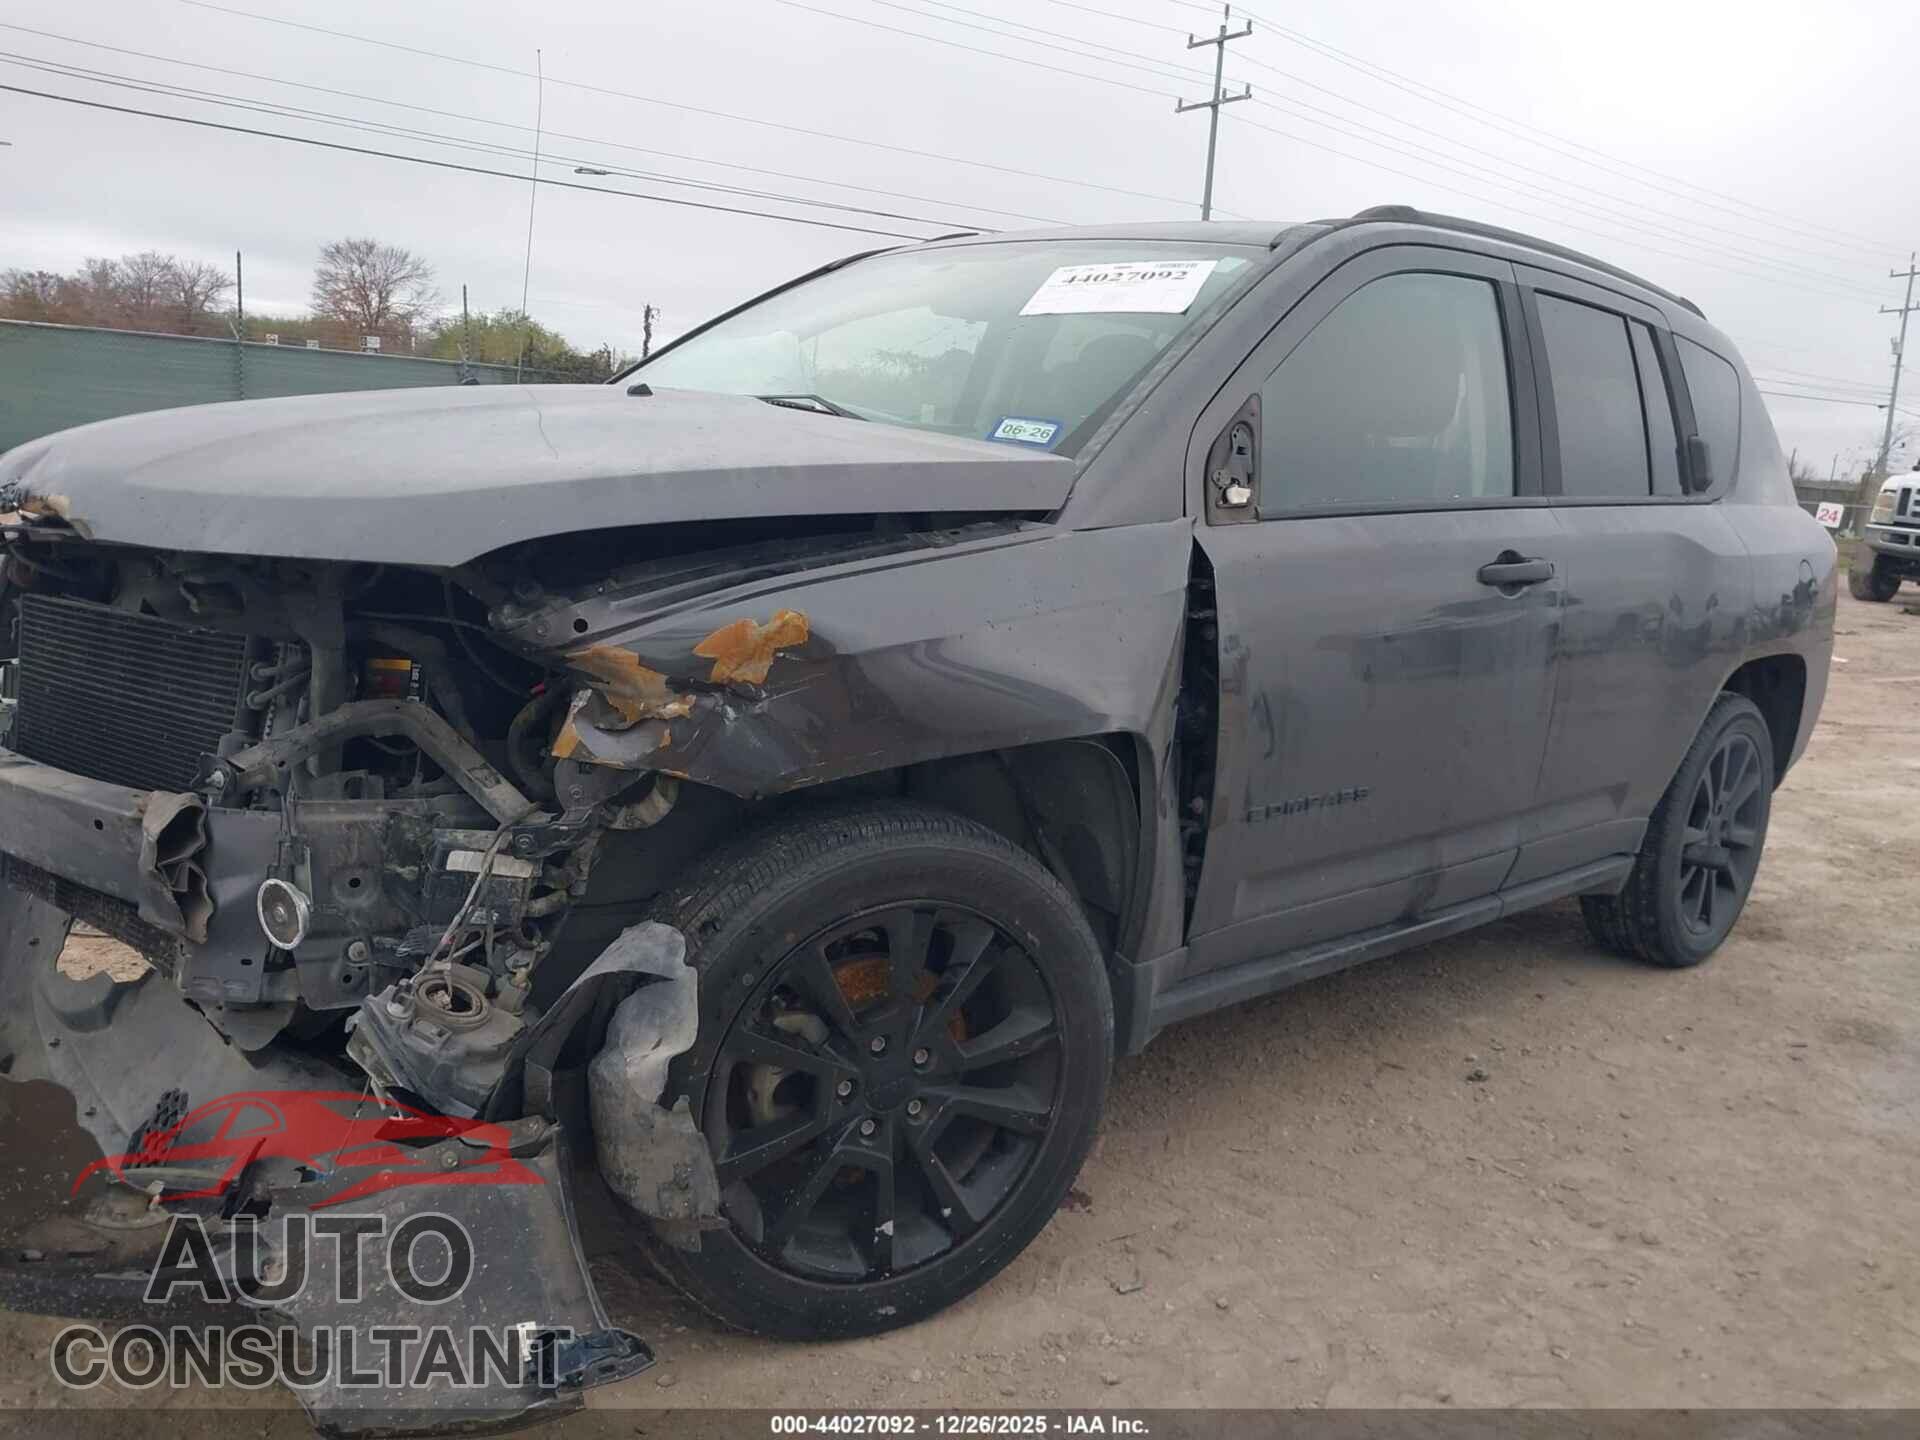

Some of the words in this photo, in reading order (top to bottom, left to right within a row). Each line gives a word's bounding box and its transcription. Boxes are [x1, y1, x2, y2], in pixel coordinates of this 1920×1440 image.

[1061, 270, 1188, 284] 44027092
[1002, 424, 1024, 435] 06
[1029, 427, 1052, 439] 26
[1818, 508, 1838, 522] 24
